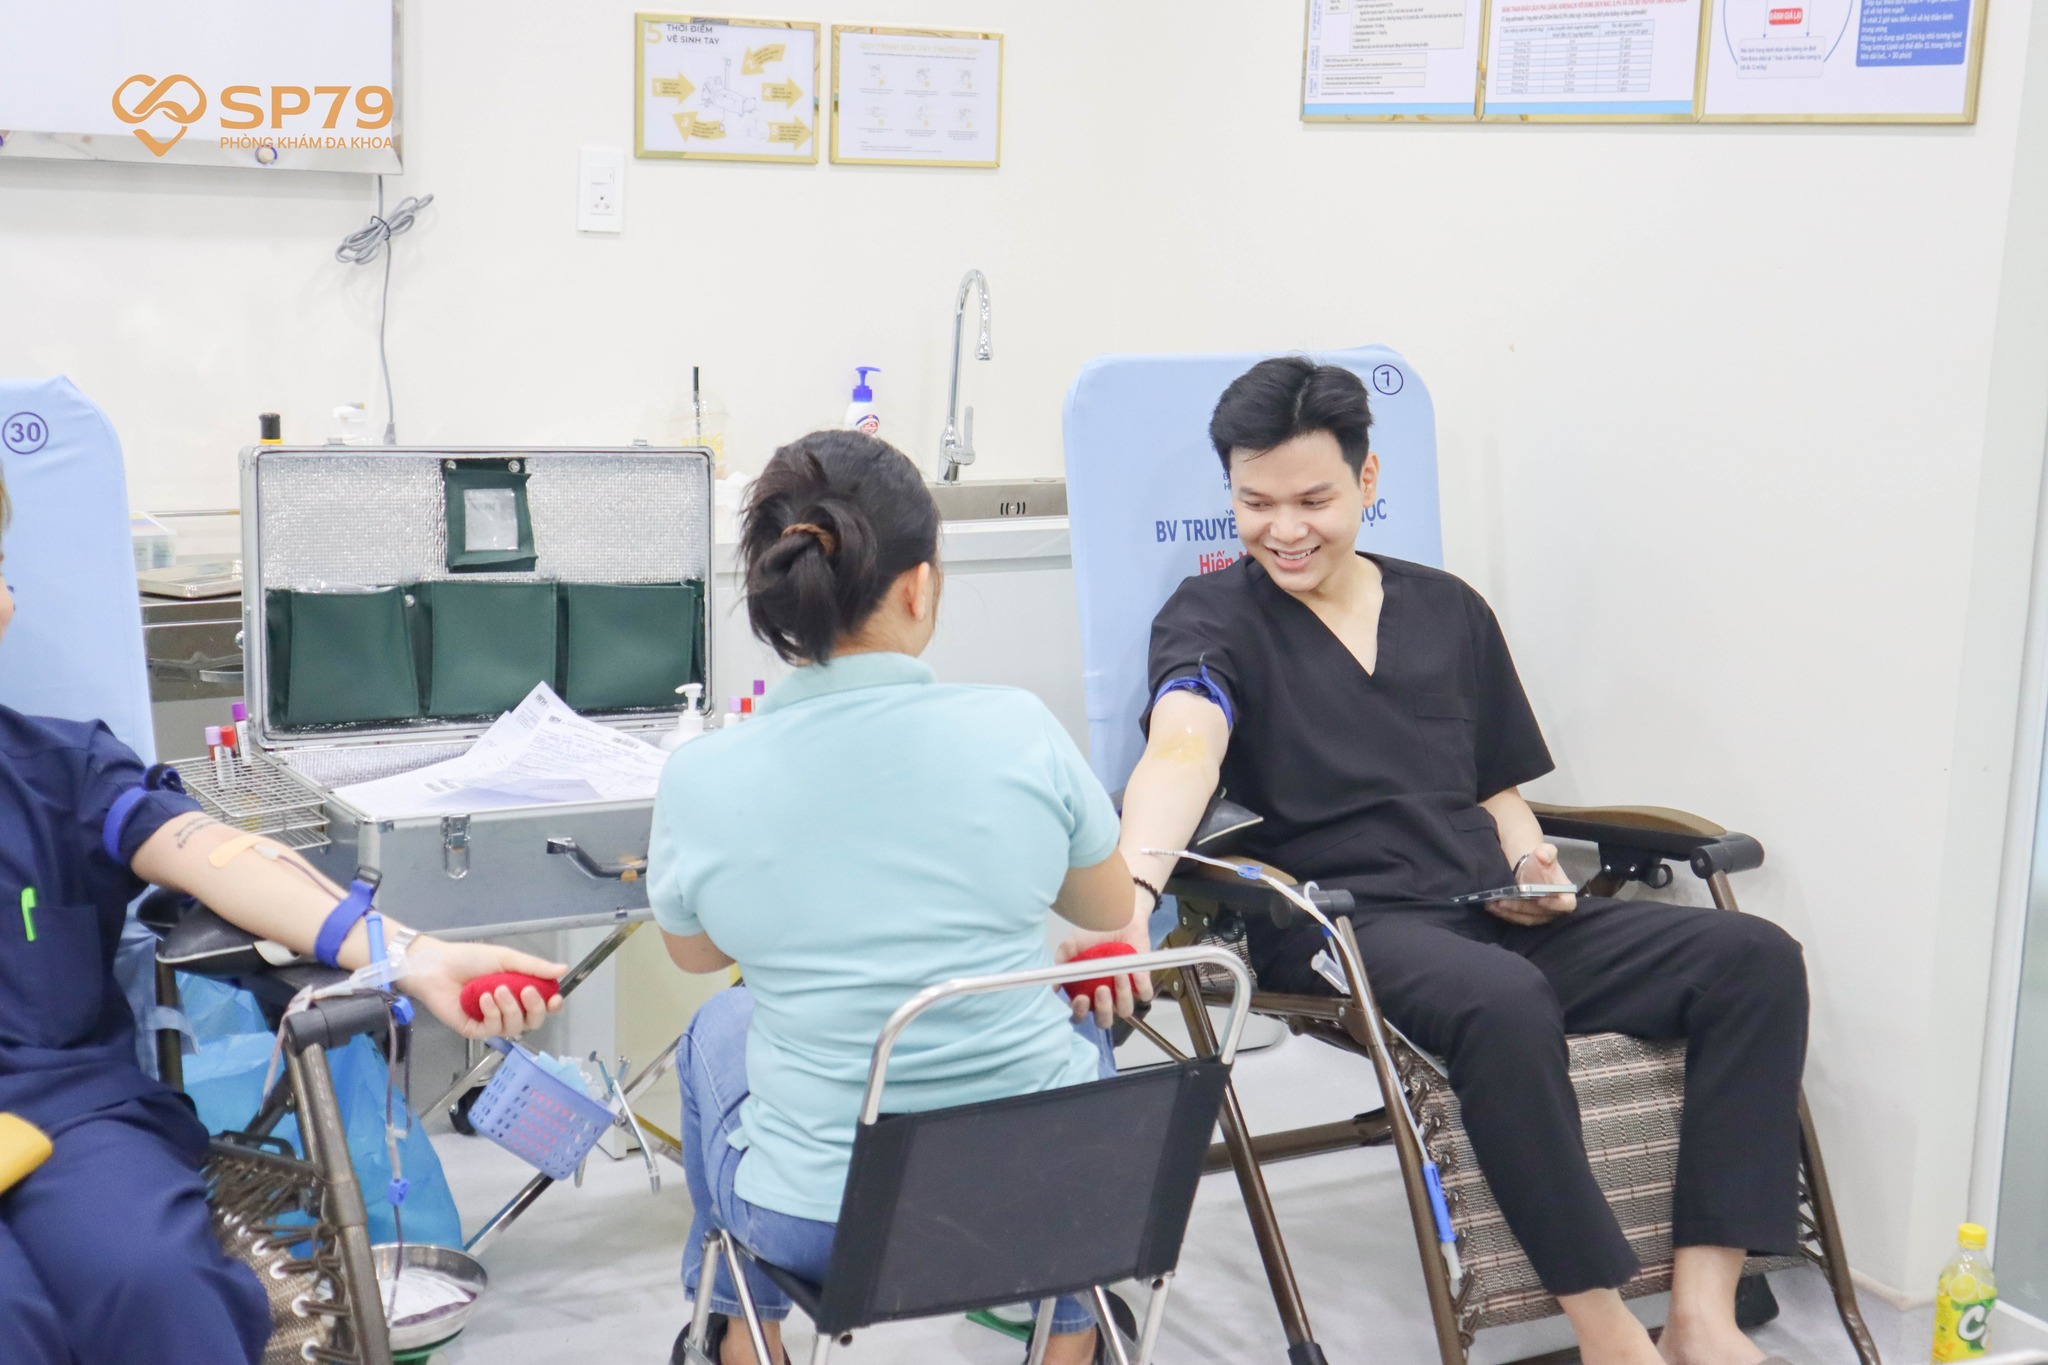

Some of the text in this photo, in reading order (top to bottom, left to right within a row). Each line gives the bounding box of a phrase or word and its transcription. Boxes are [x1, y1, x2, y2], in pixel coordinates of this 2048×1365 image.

[647, 22, 663, 44] 5
[10, 422, 42, 444] 30
[1156, 520, 1177, 542] BV
[1182, 510, 1238, 542] TRUYỀ
